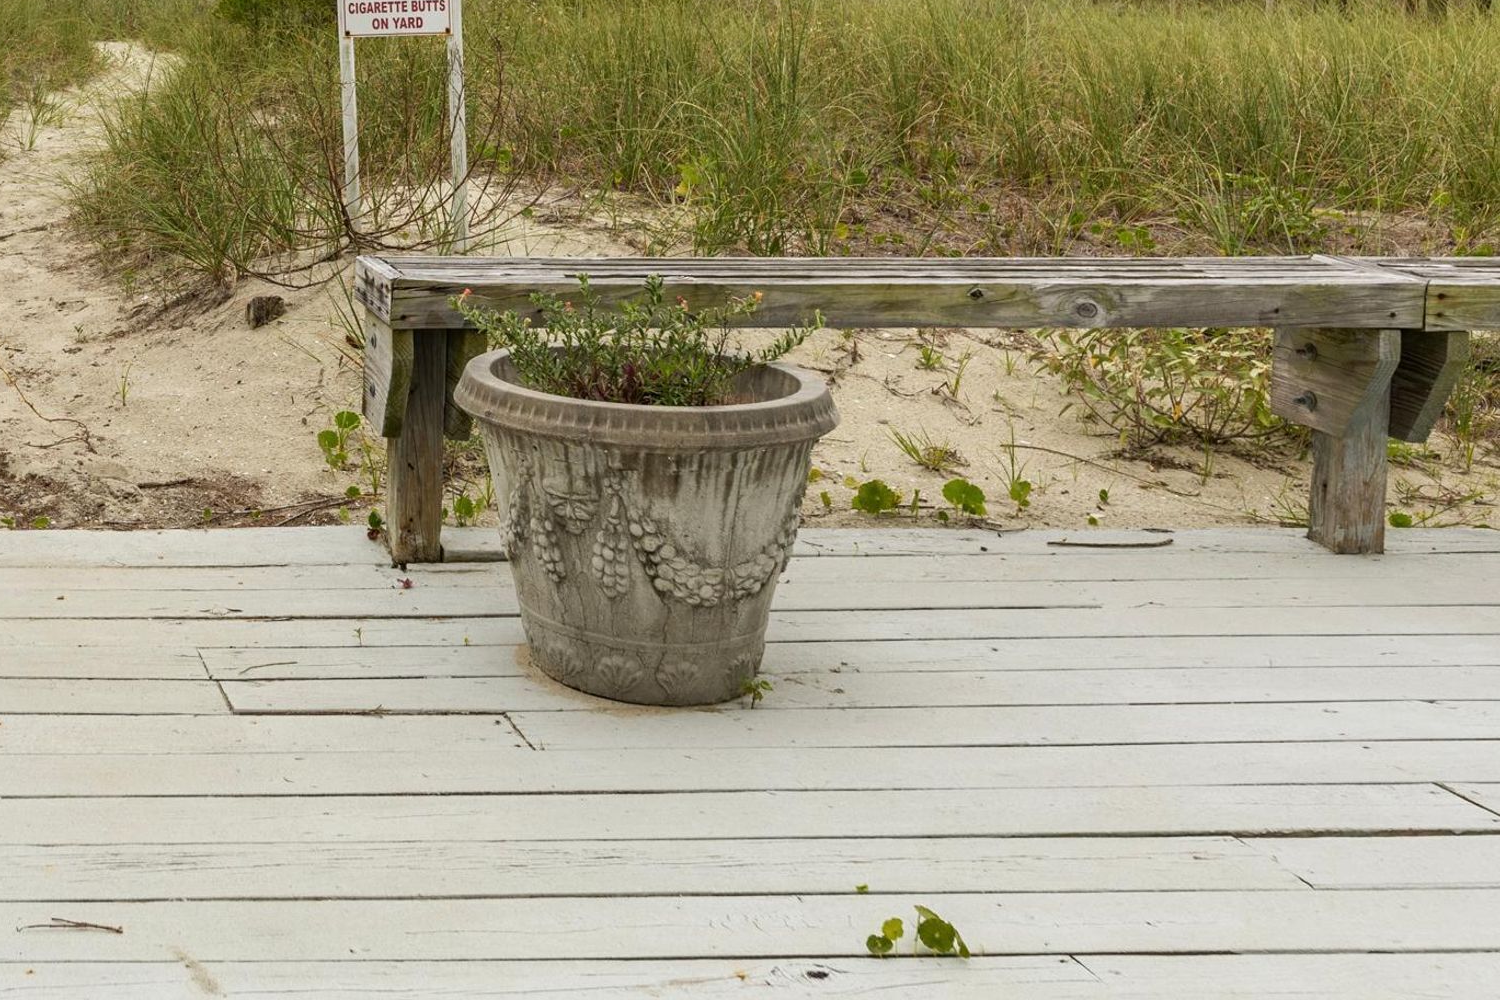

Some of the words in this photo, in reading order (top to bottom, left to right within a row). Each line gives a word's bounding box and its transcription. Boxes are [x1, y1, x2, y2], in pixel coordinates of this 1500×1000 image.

[349, 1, 407, 14] CIGARETTE
[412, 0, 445, 12] BUTTS
[372, 18, 388, 29] ON
[393, 17, 423, 28] YARD
